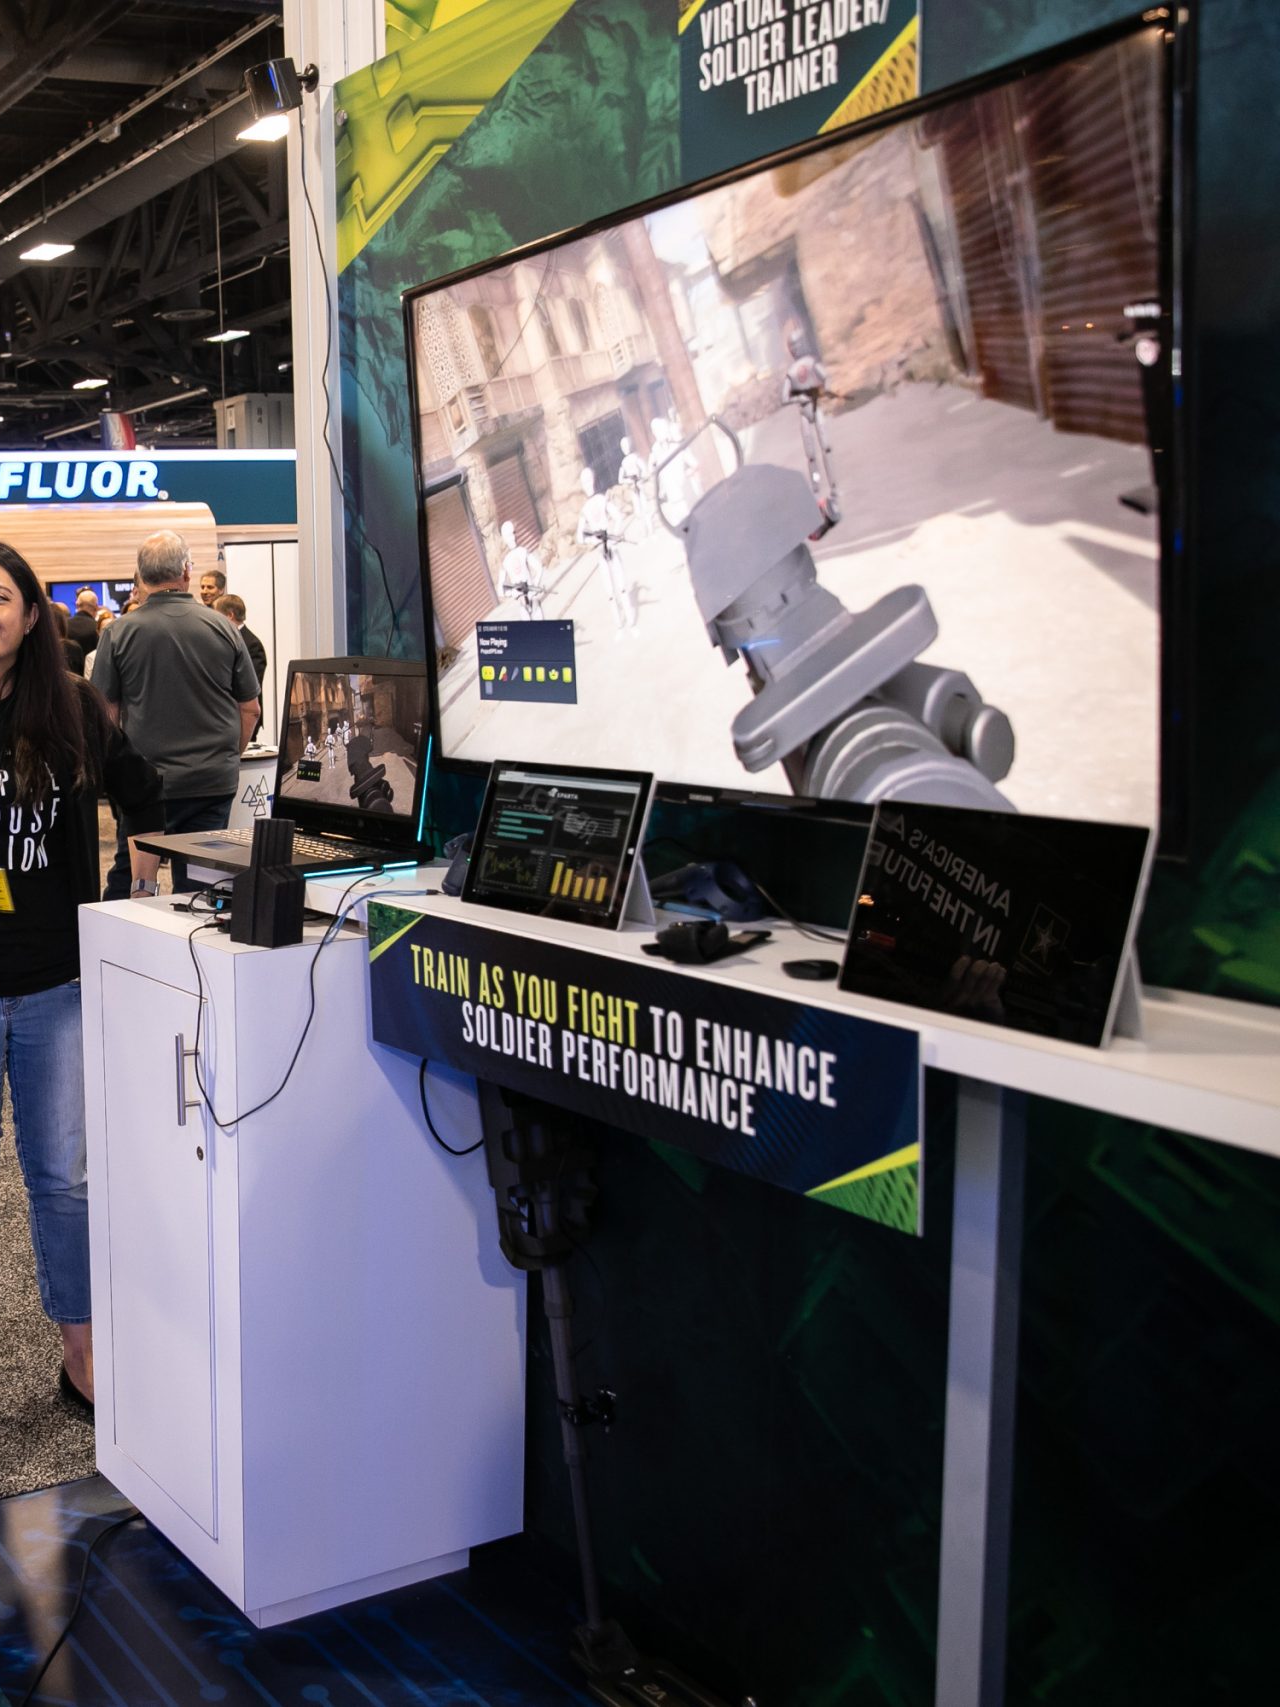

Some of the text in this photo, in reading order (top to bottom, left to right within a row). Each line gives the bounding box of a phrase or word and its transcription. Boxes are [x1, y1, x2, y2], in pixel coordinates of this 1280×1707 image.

[699, 21, 786, 92] SOLDIER
[743, 43, 839, 116] TRAINER
[410, 943, 837, 1108] TRAIN AS YOU FIGHT TO ENHANCE
[462, 1000, 757, 1137] SOLDIER PERFORMANCE
